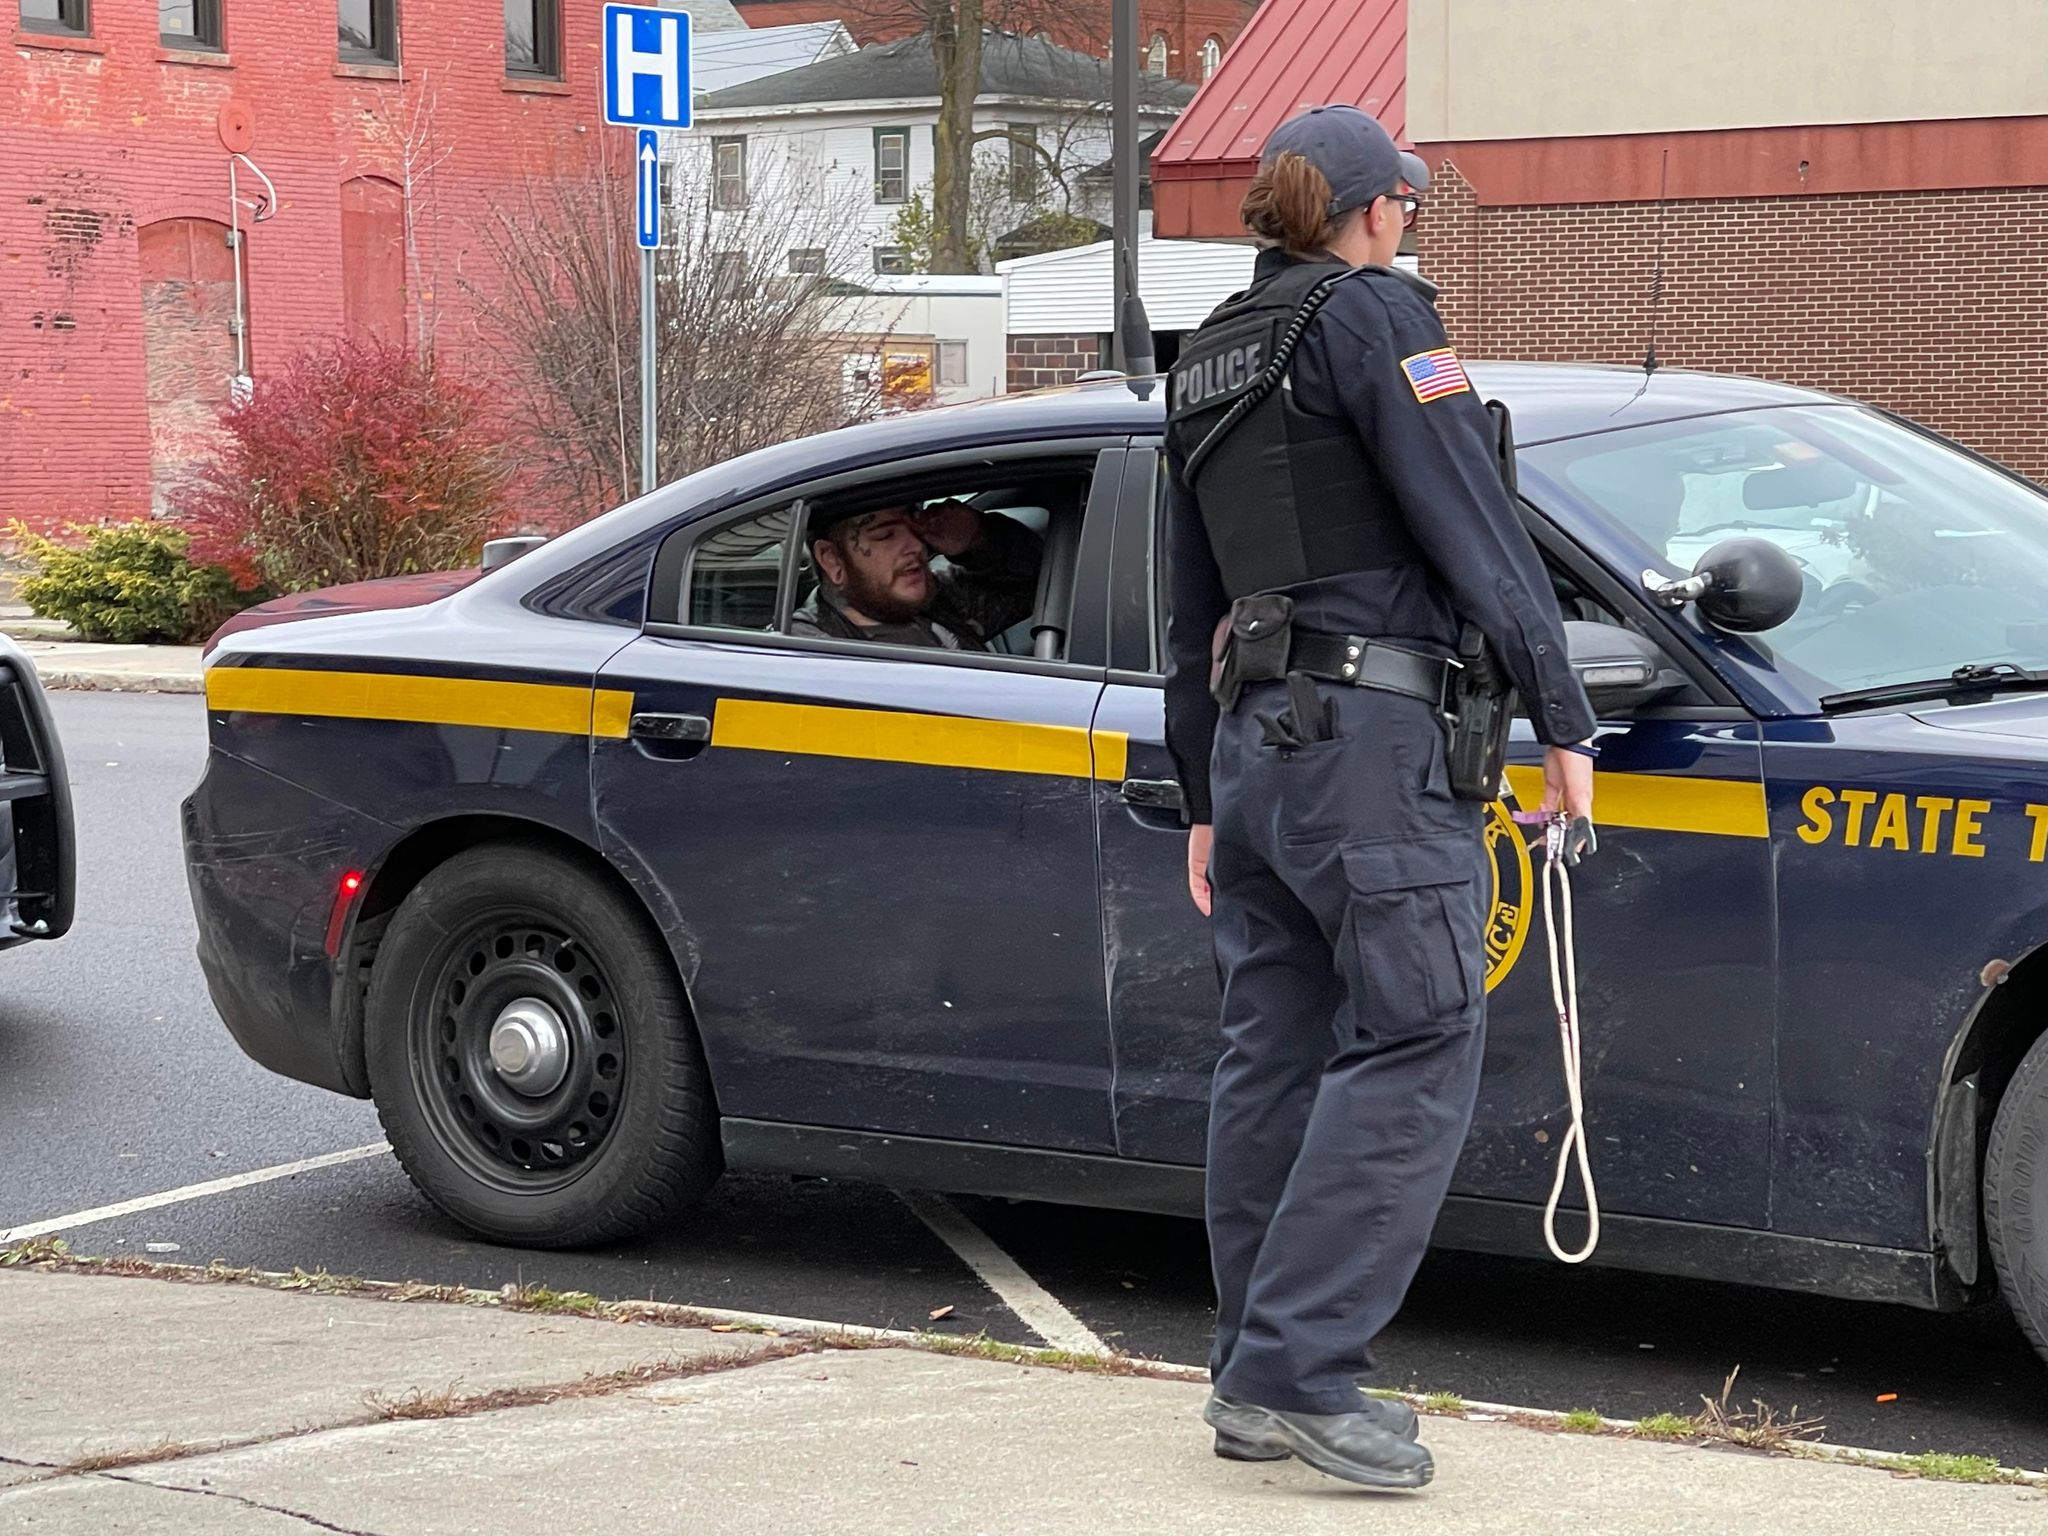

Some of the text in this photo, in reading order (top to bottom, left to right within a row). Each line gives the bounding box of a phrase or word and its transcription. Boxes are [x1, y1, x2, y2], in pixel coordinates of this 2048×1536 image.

[616, 13, 679, 121] H
[1175, 342, 1262, 411] POLICE
[1796, 786, 1991, 857] STATE
